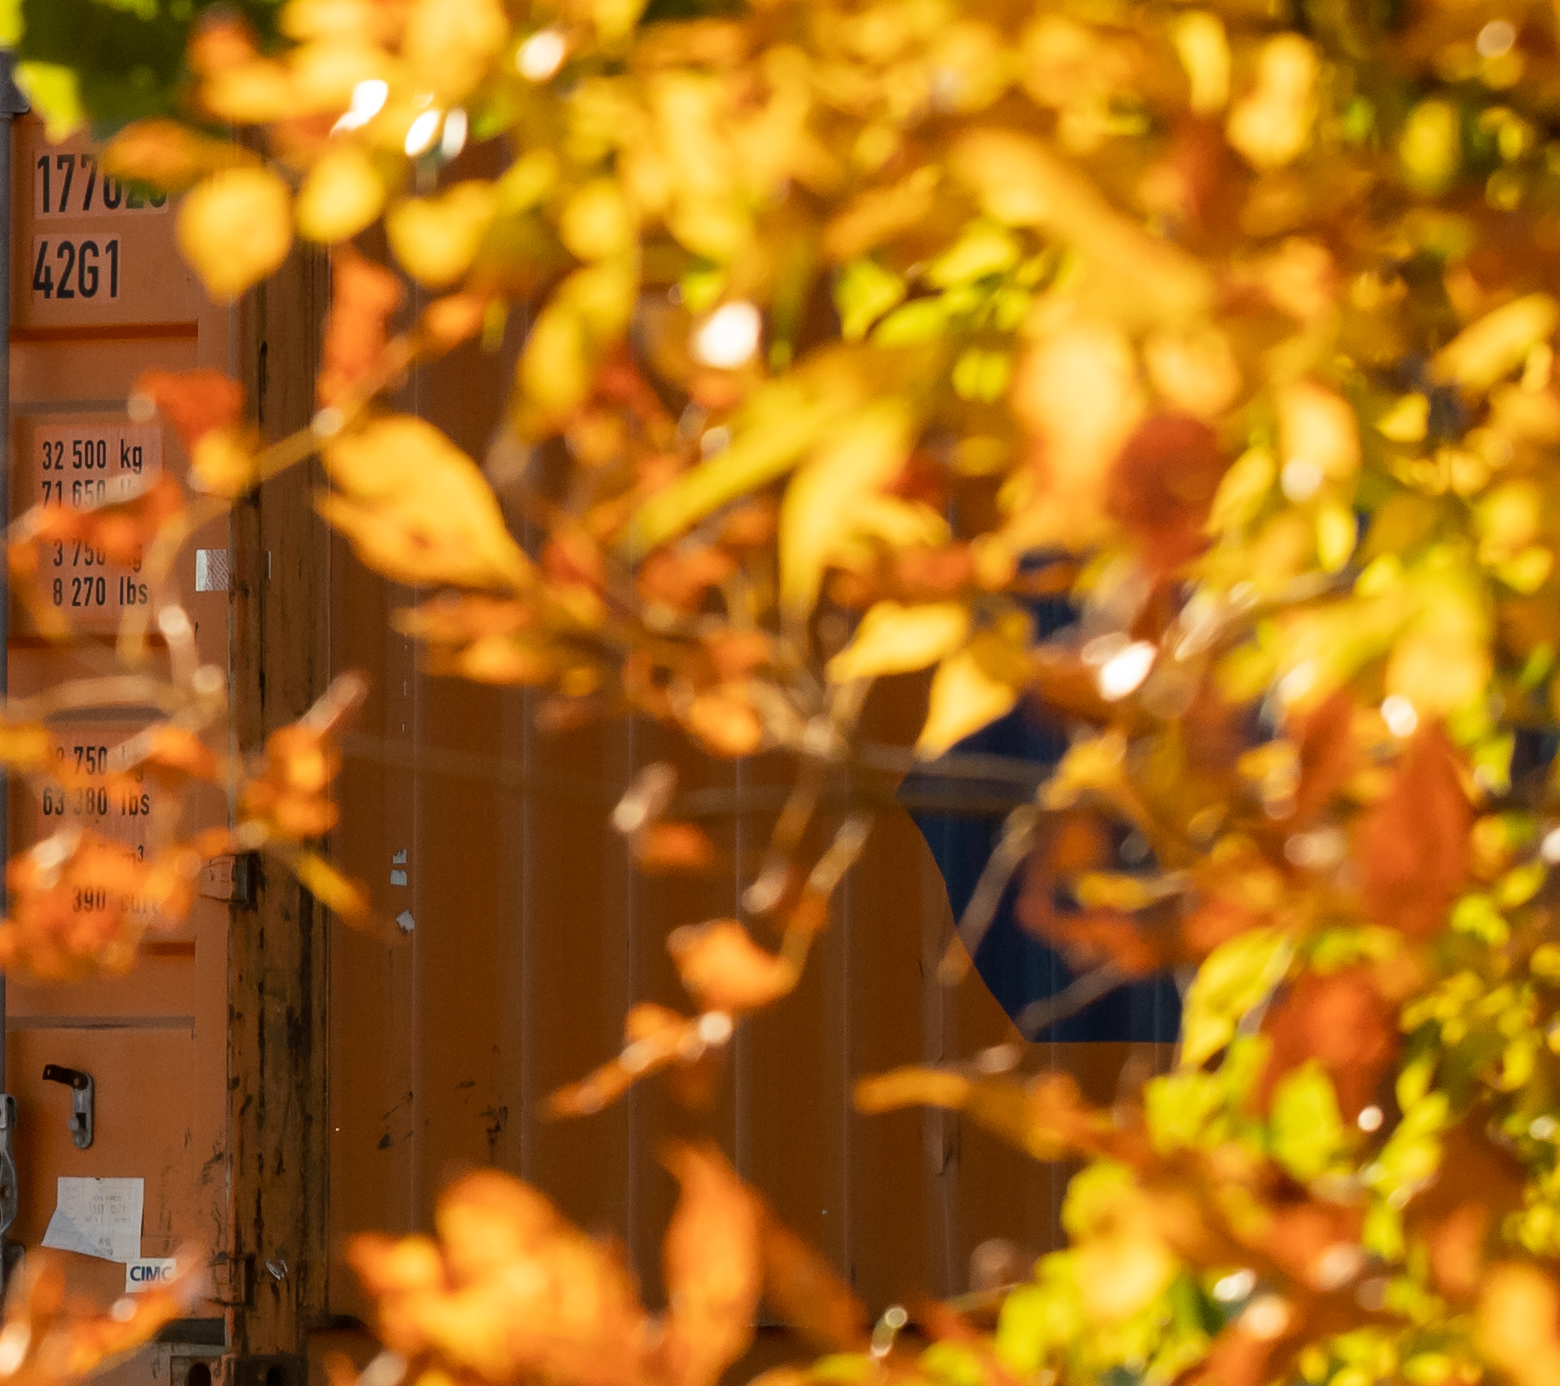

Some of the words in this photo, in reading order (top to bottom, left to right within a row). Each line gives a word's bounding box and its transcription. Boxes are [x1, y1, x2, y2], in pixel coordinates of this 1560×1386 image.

[32, 239, 118, 299] 42G1
[41, 440, 64, 470] 32
[72, 439, 107, 470] 500
[120, 439, 143, 474] kg
[52, 577, 63, 607] 8
[72, 576, 107, 607] 270
[119, 576, 148, 606] lbs
